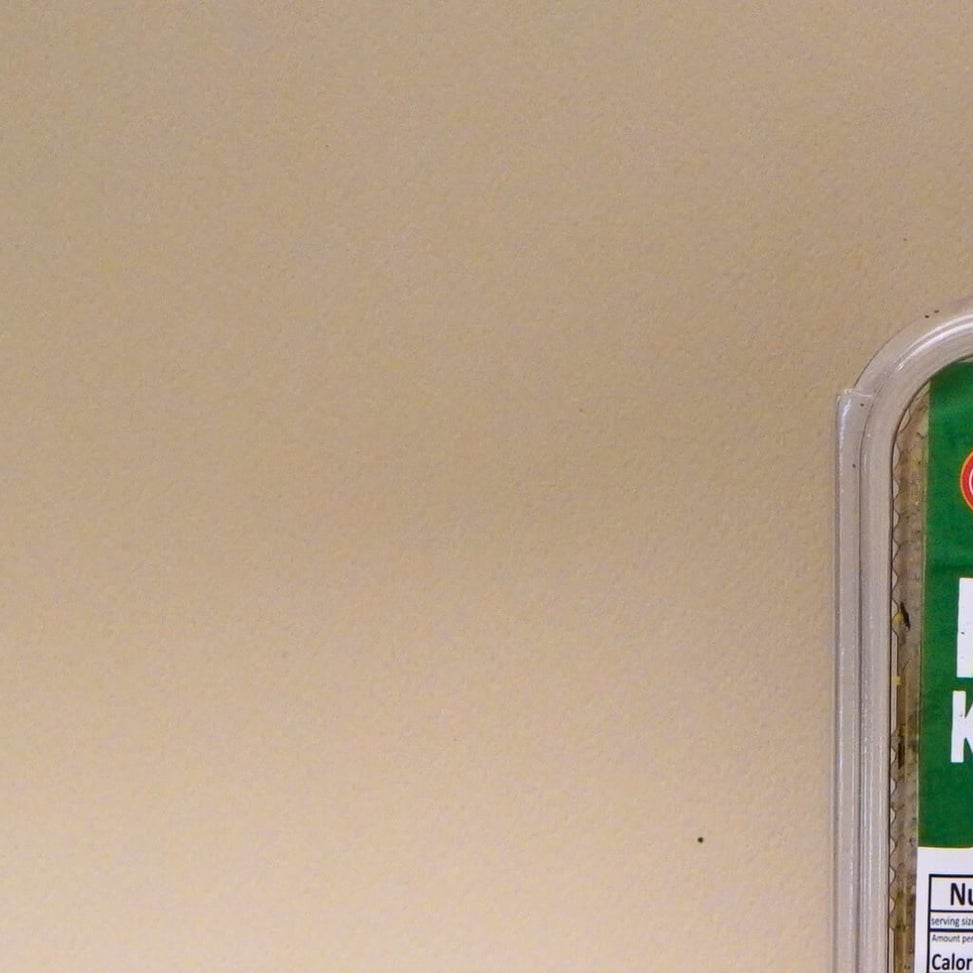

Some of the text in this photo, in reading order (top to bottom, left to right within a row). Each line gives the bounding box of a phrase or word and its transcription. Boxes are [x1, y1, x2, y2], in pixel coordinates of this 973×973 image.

[930, 917, 960, 928] serving
[931, 934, 960, 943] Amount
[962, 936, 973, 944] per
